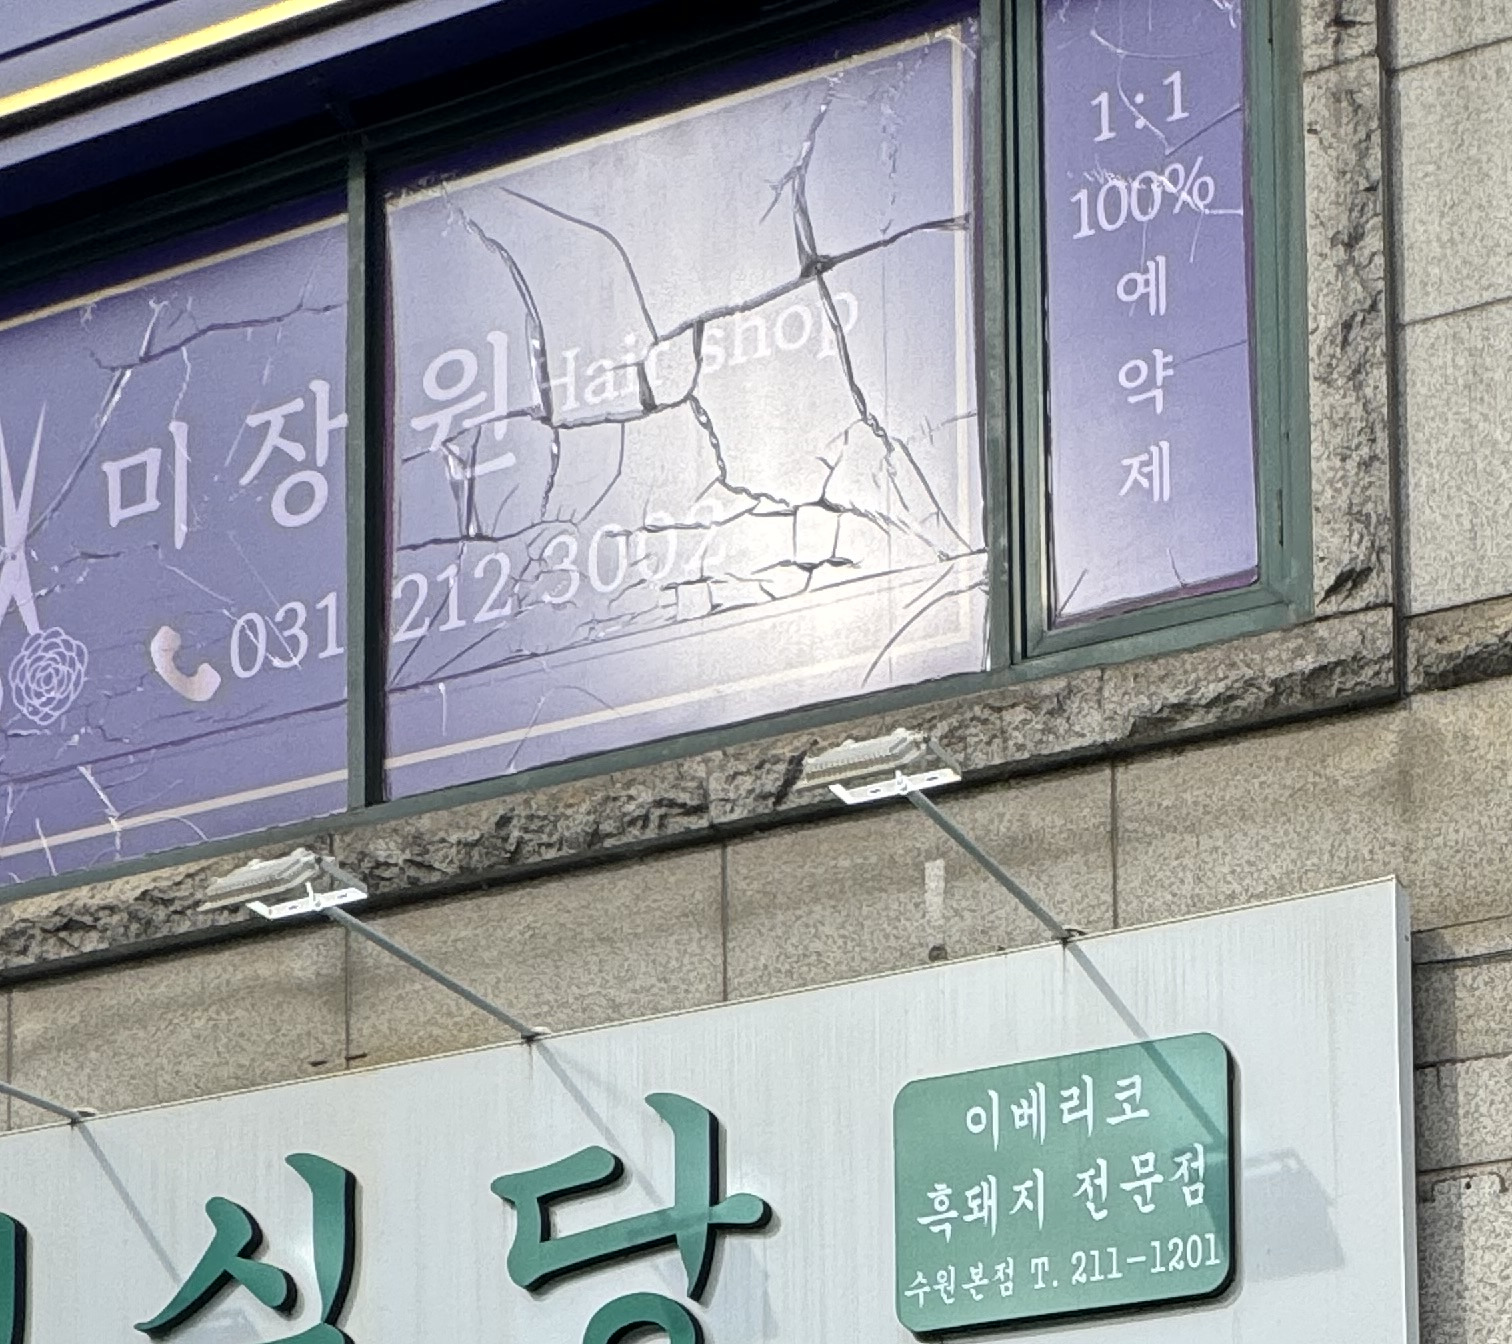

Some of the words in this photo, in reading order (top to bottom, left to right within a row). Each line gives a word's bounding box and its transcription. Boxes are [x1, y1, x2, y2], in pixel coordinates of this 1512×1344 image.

[1089, 68, 1190, 143] 1:1
[1069, 160, 1217, 242] 100%
[1115, 255, 1177, 504] 예약제
[101, 330, 517, 551] 미장원
[230, 588, 346, 682] 031
[391, 550, 513, 644] 212
[966, 1073, 1150, 1152] 이베리코
[916, 1167, 1045, 1244] 흑돼지
[1072, 1142, 1206, 1222] 전문점
[1070, 1232, 1221, 1285] 211-1201
